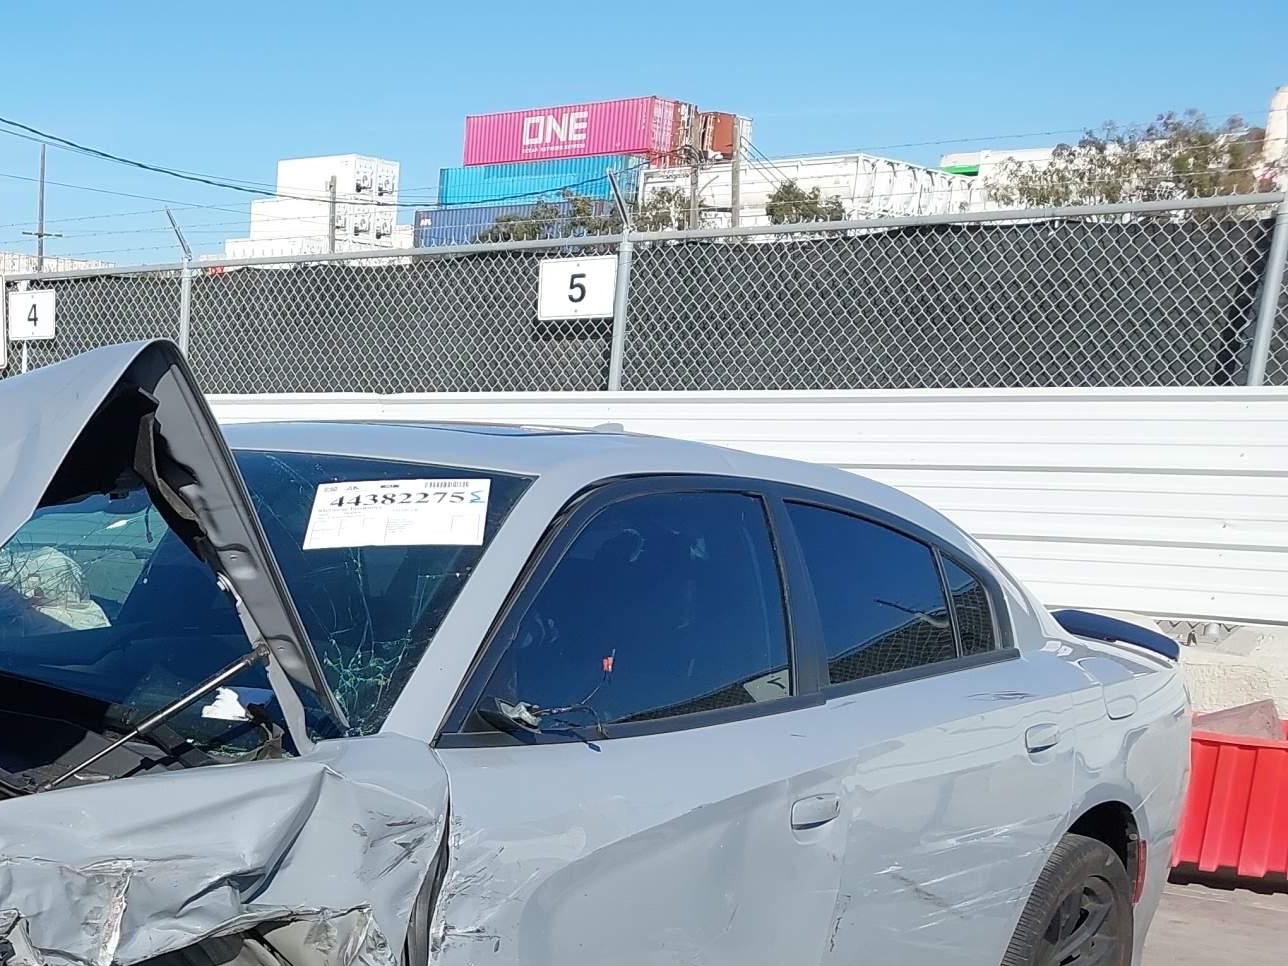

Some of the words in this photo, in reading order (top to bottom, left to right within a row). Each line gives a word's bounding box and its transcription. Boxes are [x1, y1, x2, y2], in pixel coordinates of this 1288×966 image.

[522, 111, 588, 145] ONE
[567, 272, 587, 304] 5
[27, 303, 39, 327] 4
[329, 491, 465, 508] 44382275
